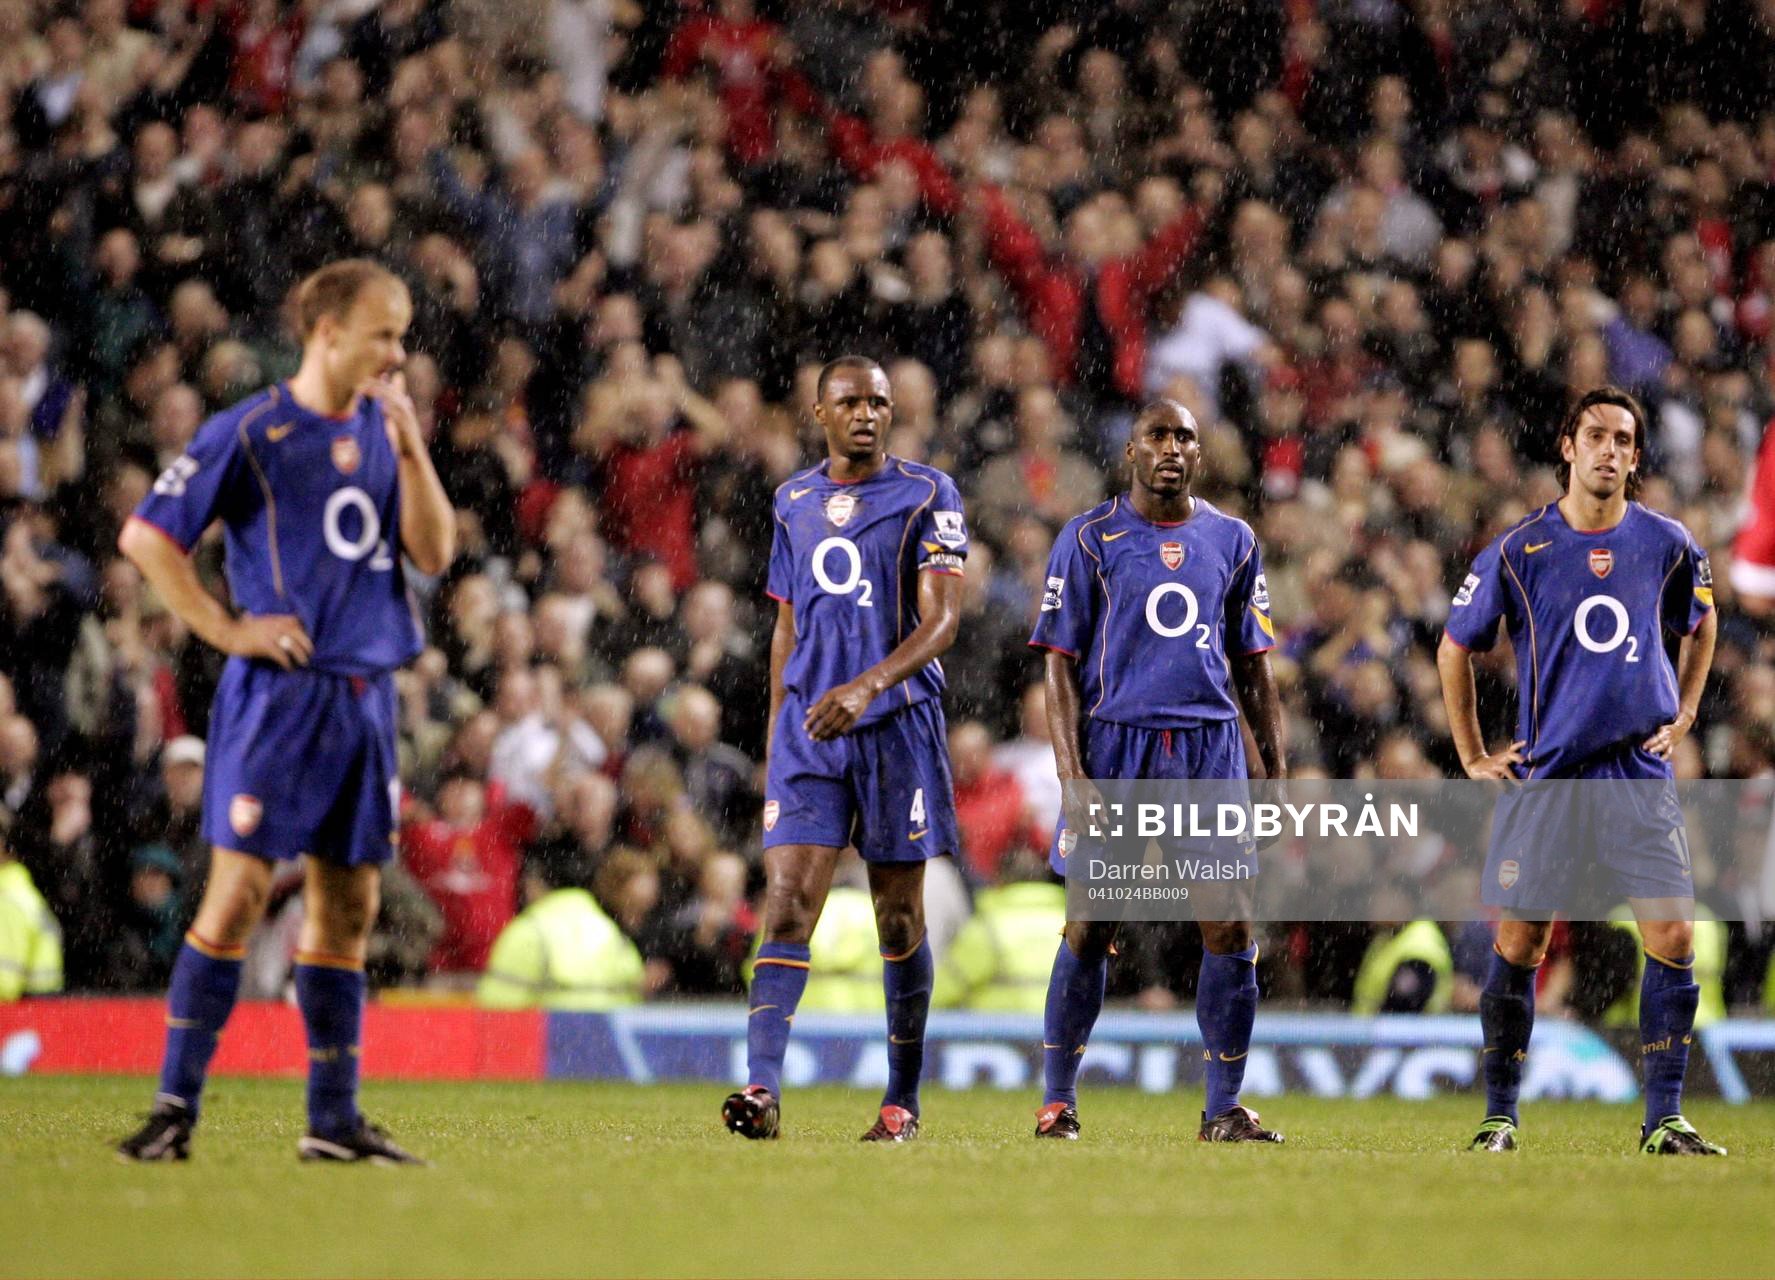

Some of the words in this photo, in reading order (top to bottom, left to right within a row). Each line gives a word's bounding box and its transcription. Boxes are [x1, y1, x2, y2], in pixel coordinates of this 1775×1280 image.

[812, 536, 873, 607] O2
[1145, 582, 1210, 649] O2
[1573, 594, 1639, 662] O2
[909, 788, 926, 828] 4
